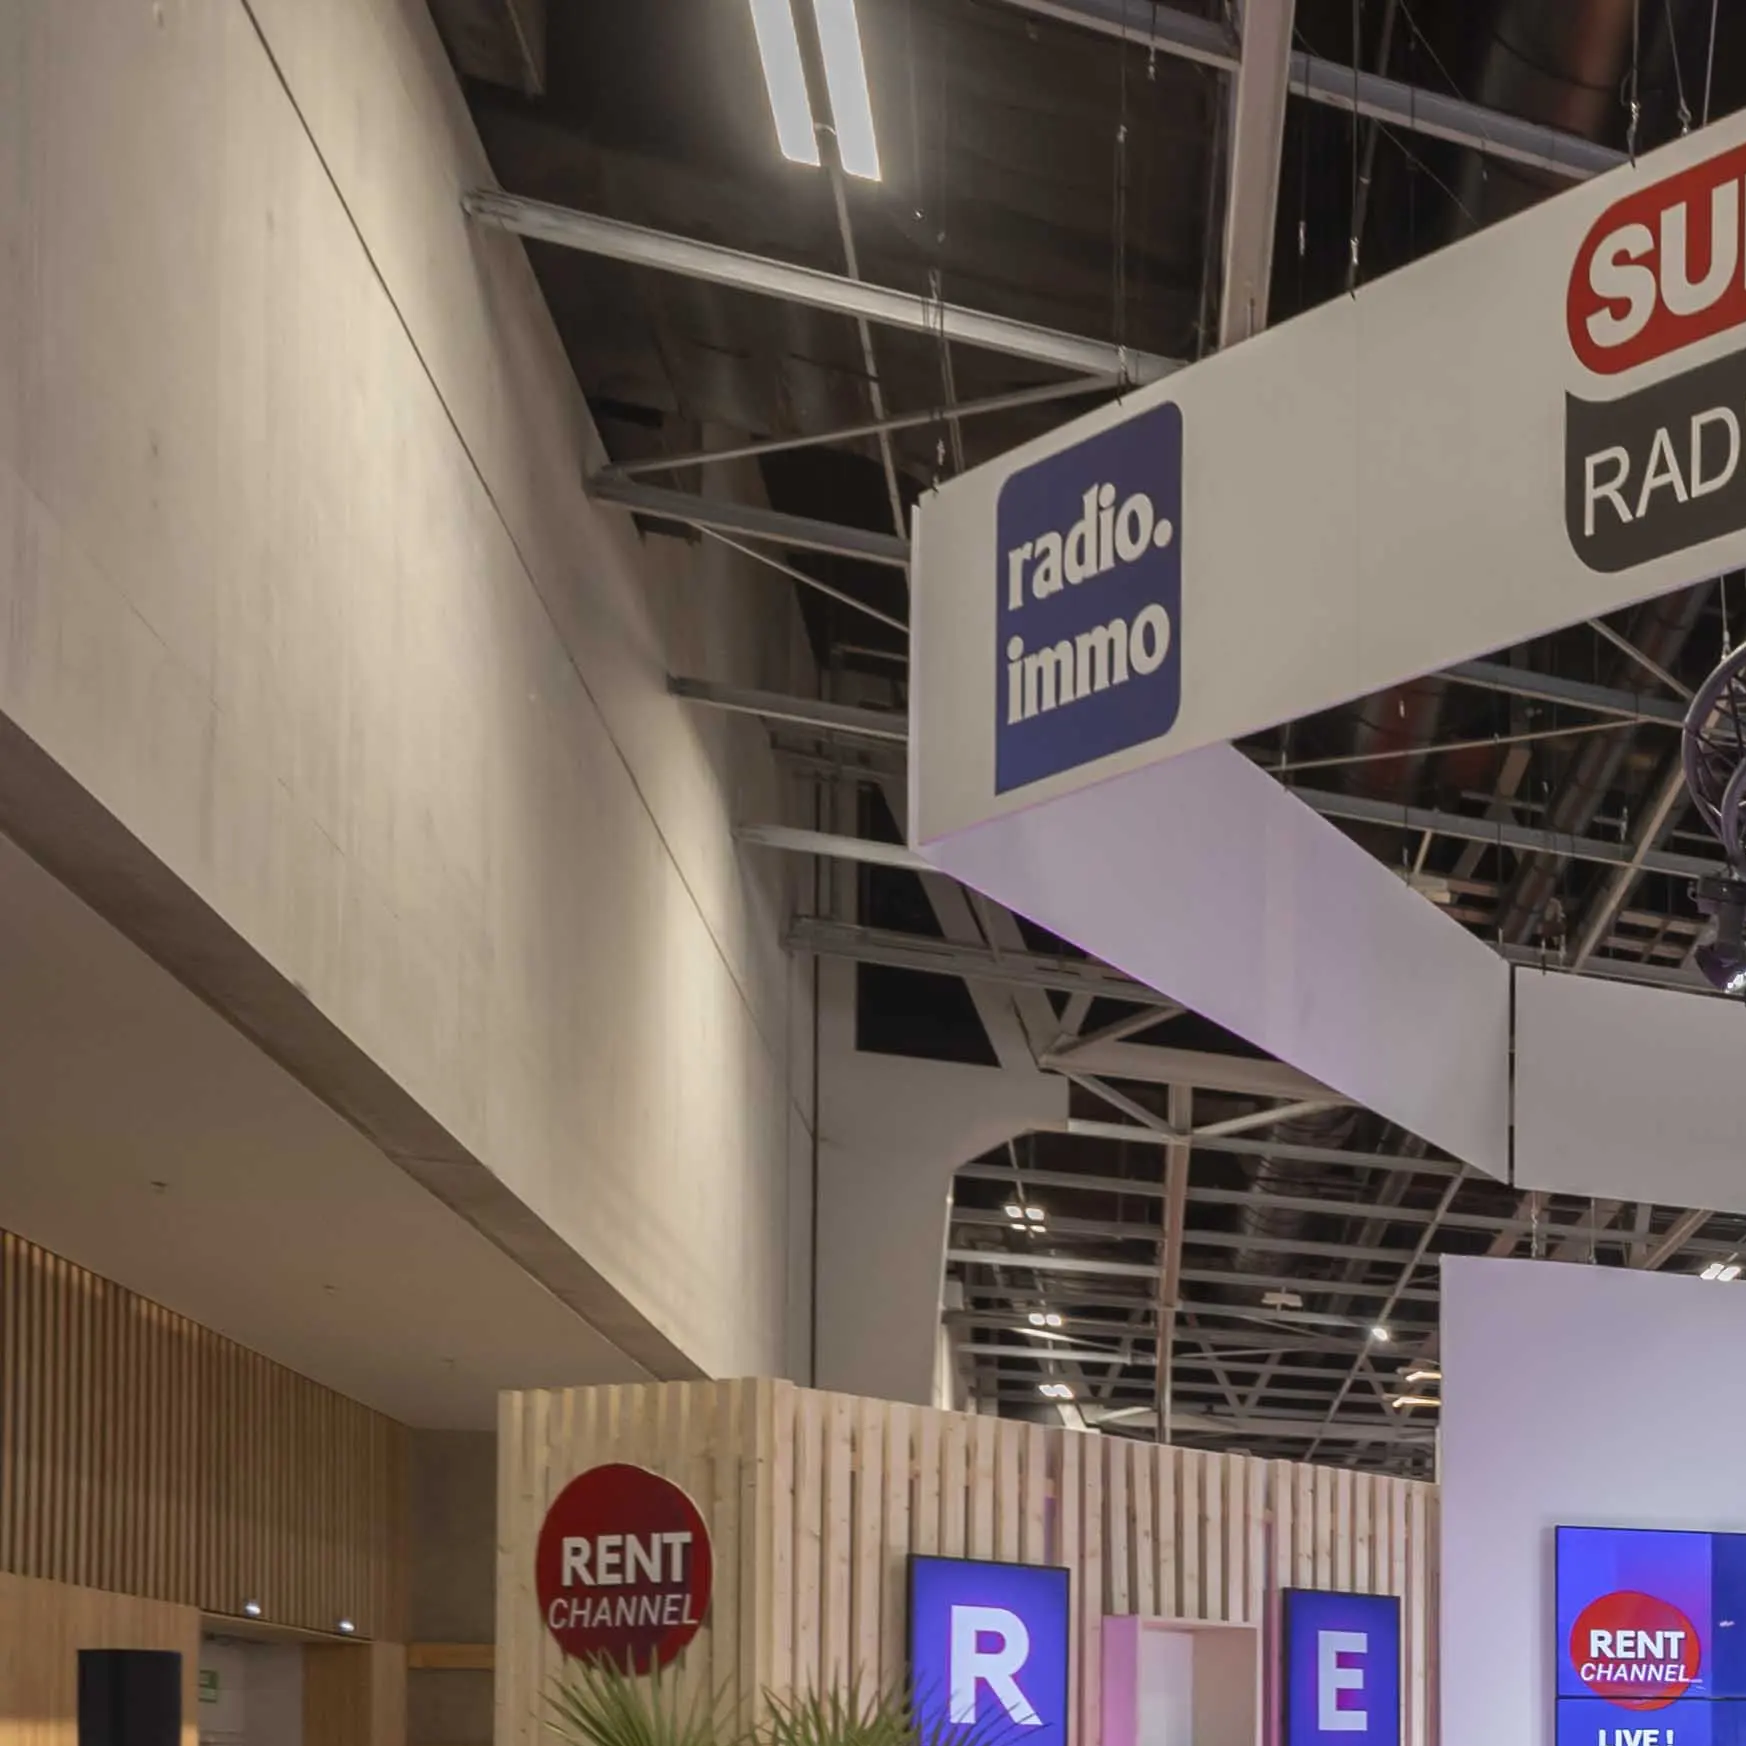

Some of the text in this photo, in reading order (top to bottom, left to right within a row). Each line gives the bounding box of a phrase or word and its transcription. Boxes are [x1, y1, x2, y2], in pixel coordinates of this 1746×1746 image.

[1007, 482, 1173, 610] radio.
[1007, 602, 1170, 725] immo
[561, 1531, 693, 1587] RENT
[548, 1592, 699, 1630] CHANNEL
[1589, 1629, 1686, 1659] RENT
[949, 1604, 1042, 1726] R
[1318, 1630, 1368, 1733] E
[1580, 1662, 1691, 1682] CHANNEL
